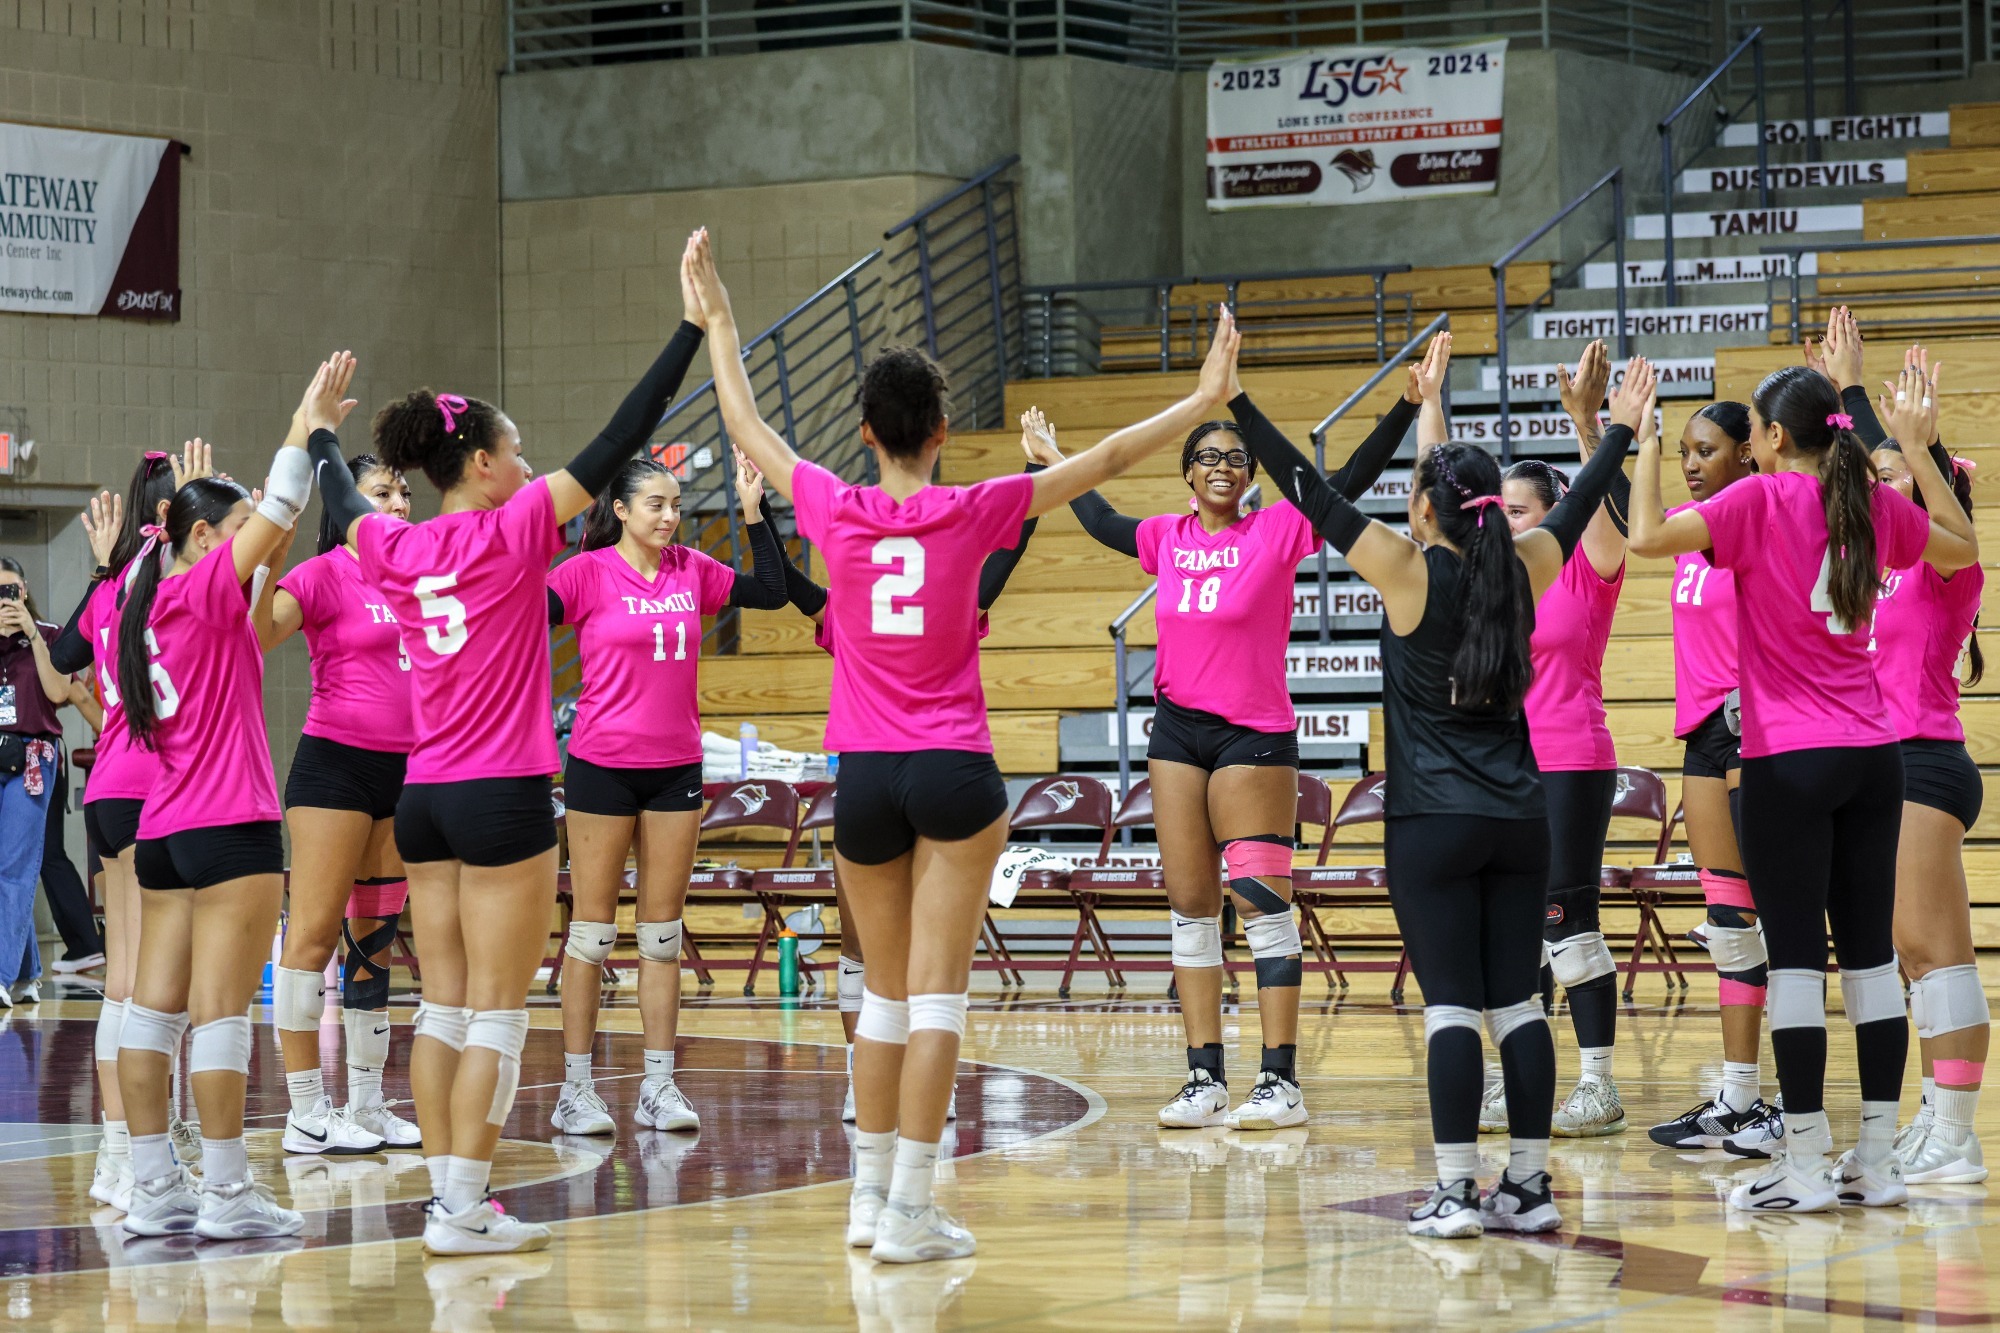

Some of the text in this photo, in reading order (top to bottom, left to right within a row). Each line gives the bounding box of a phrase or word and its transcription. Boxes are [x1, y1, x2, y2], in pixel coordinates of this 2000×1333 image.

[1428, 52, 1488, 76] 2024
[1222, 68, 1280, 91] 2023
[1299, 56, 1386, 107] LSC
[1278, 108, 1434, 128] LONE STAR CONFERENCE
[1228, 121, 1485, 150] ATHLETIC TRAINING STAFF OF THE YEAR
[1711, 163, 1884, 192] DUSTDEVILS
[0, 212, 97, 245] MMUNITY
[1710, 211, 1798, 236] TAMIU
[6, 243, 41, 260] Center
[0, 285, 74, 303] tewaychc.com
[1545, 312, 1767, 337] FIGHT! FIGHT! FIGHT
[871, 536, 926, 636] 2
[1178, 576, 1222, 613] 18
[1675, 563, 1710, 605] 21
[413, 570, 468, 656] 5
[621, 590, 696, 615] TAMIU
[652, 621, 687, 662] 11
[1306, 656, 1359, 672] FROM
